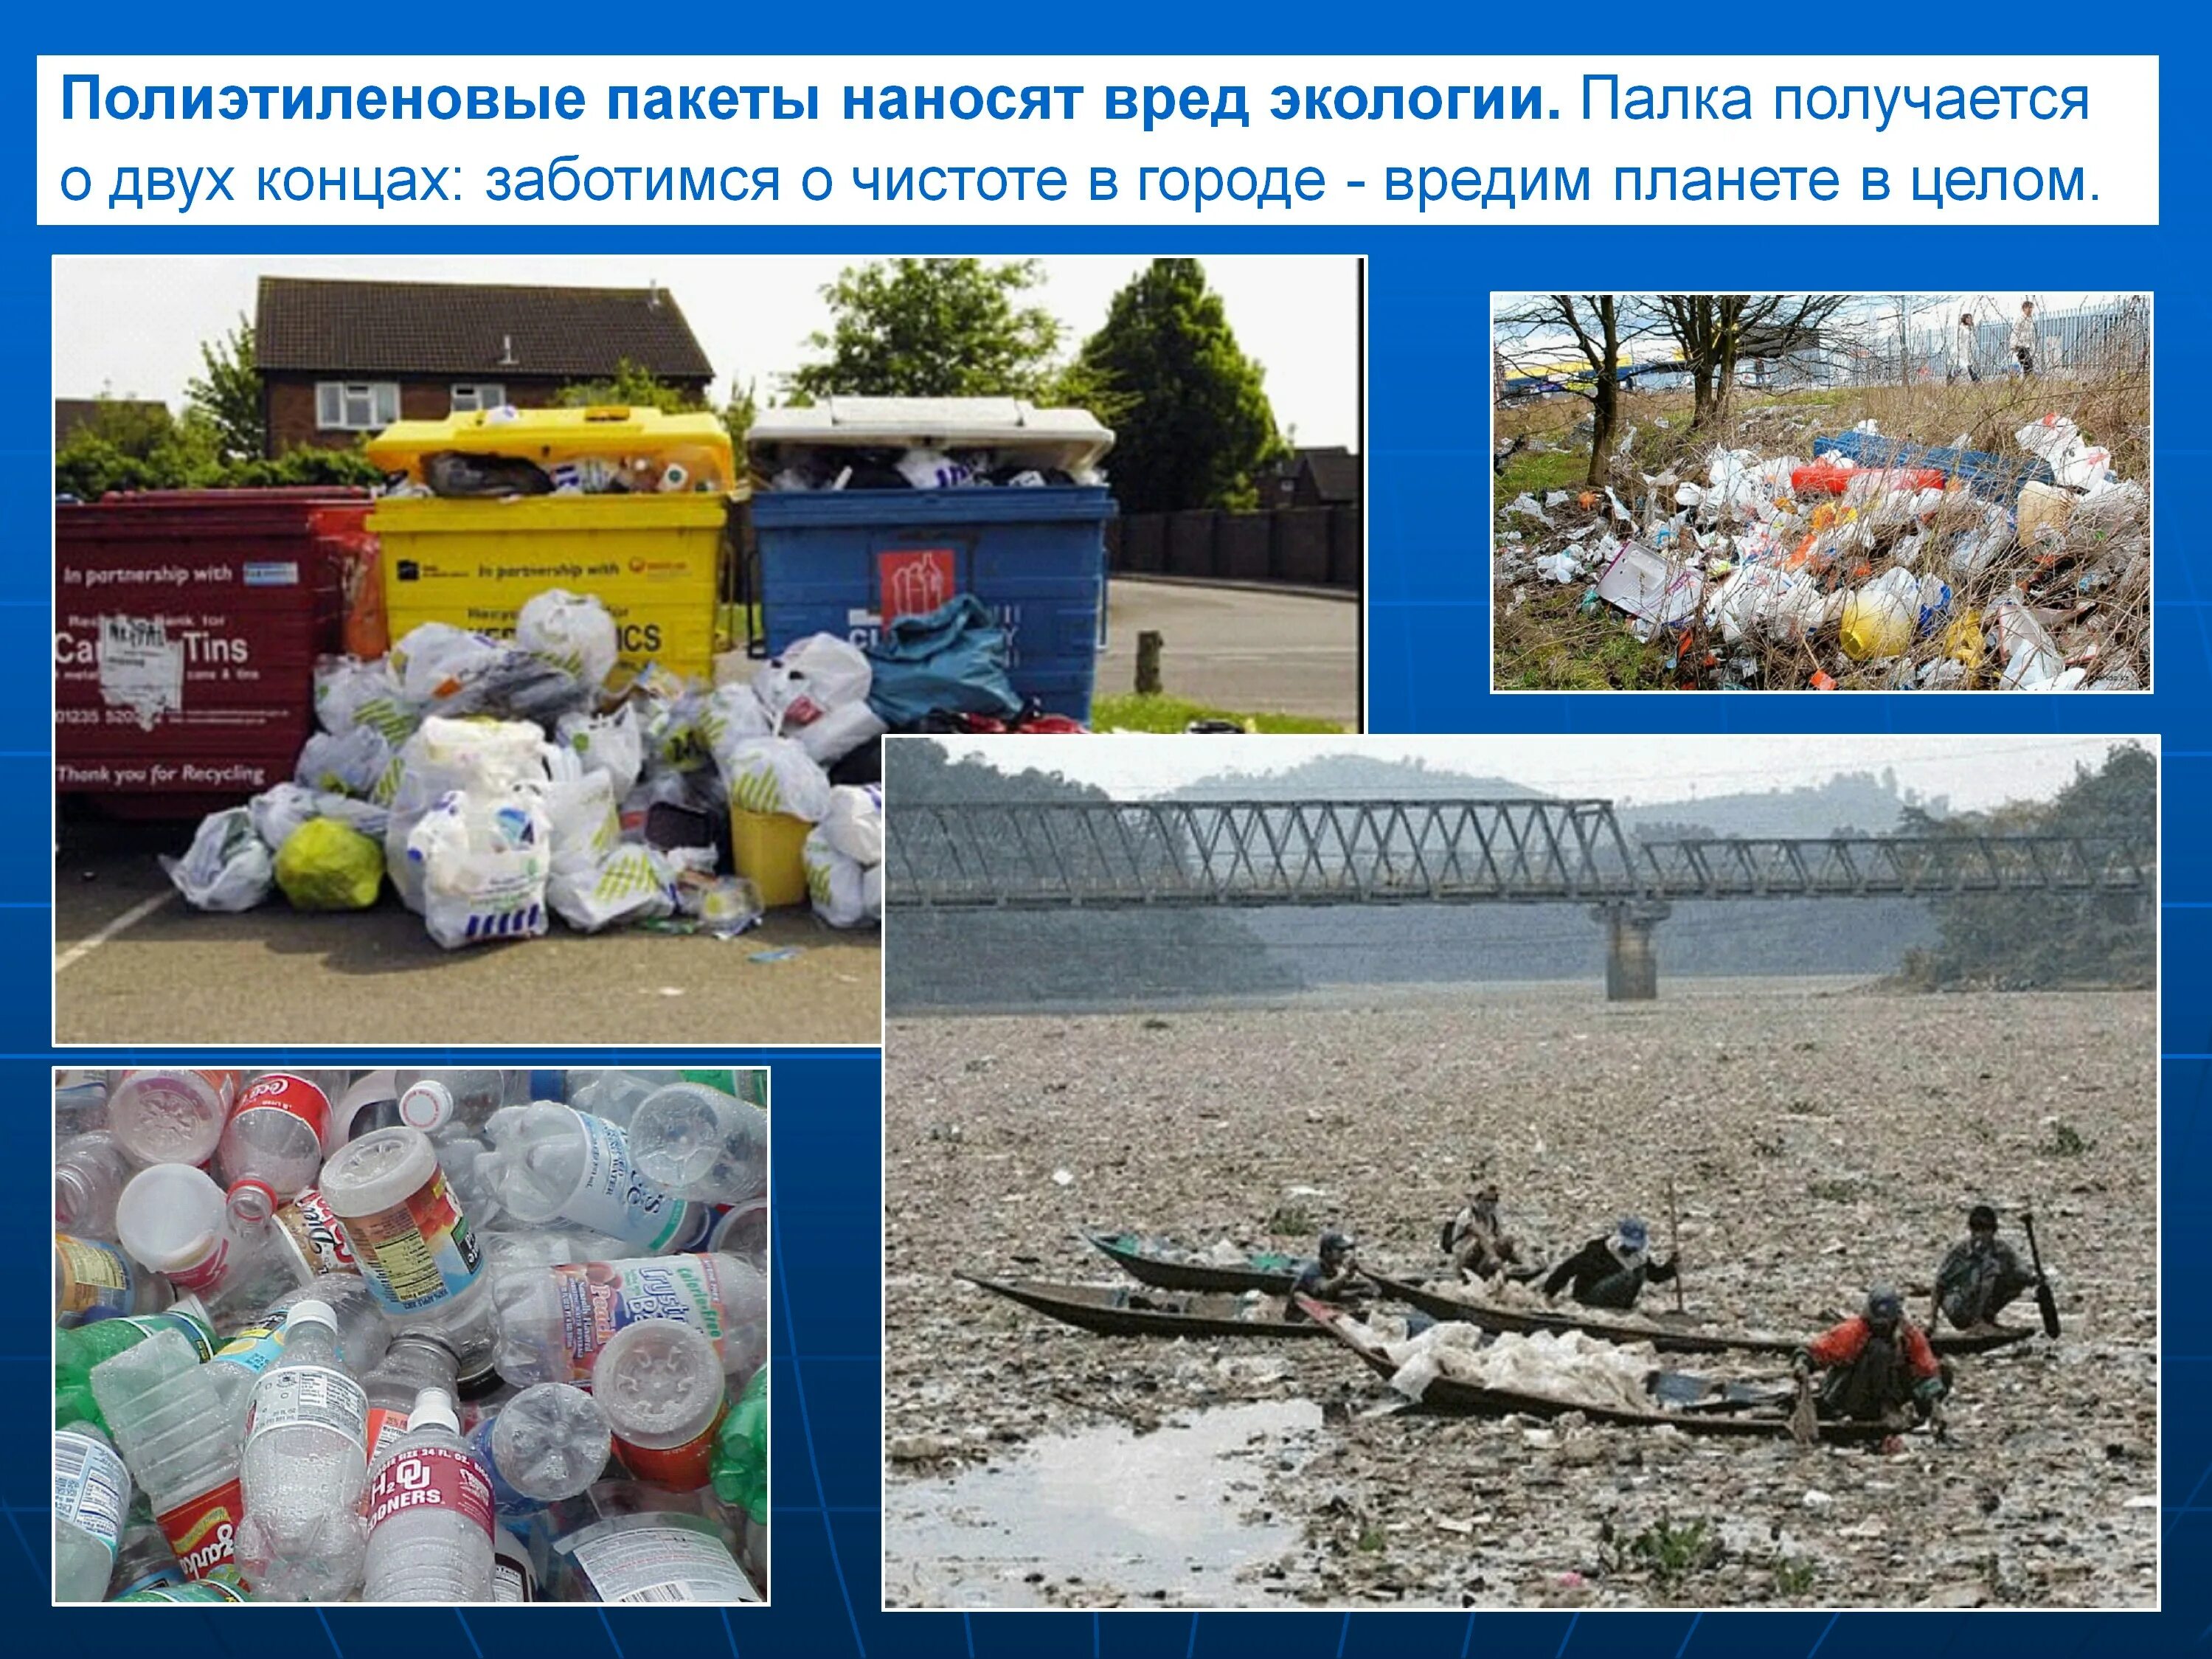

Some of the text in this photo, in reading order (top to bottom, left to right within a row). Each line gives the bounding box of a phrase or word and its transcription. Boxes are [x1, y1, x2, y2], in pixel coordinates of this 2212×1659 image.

[63, 565, 82, 583] In
[85, 566, 189, 589] partnership
[193, 565, 233, 583] with
[496, 564, 583, 582] partnership
[588, 563, 620, 576] with
[181, 631, 249, 662] Tins
[615, 624, 662, 652] ICS
[57, 763, 266, 786] Thank you for Recycling
[590, 1284, 616, 1345] Peach
[398, 1450, 418, 1464] SIZE
[422, 1448, 435, 1457] 24
[368, 1489, 443, 1532] OONERS
